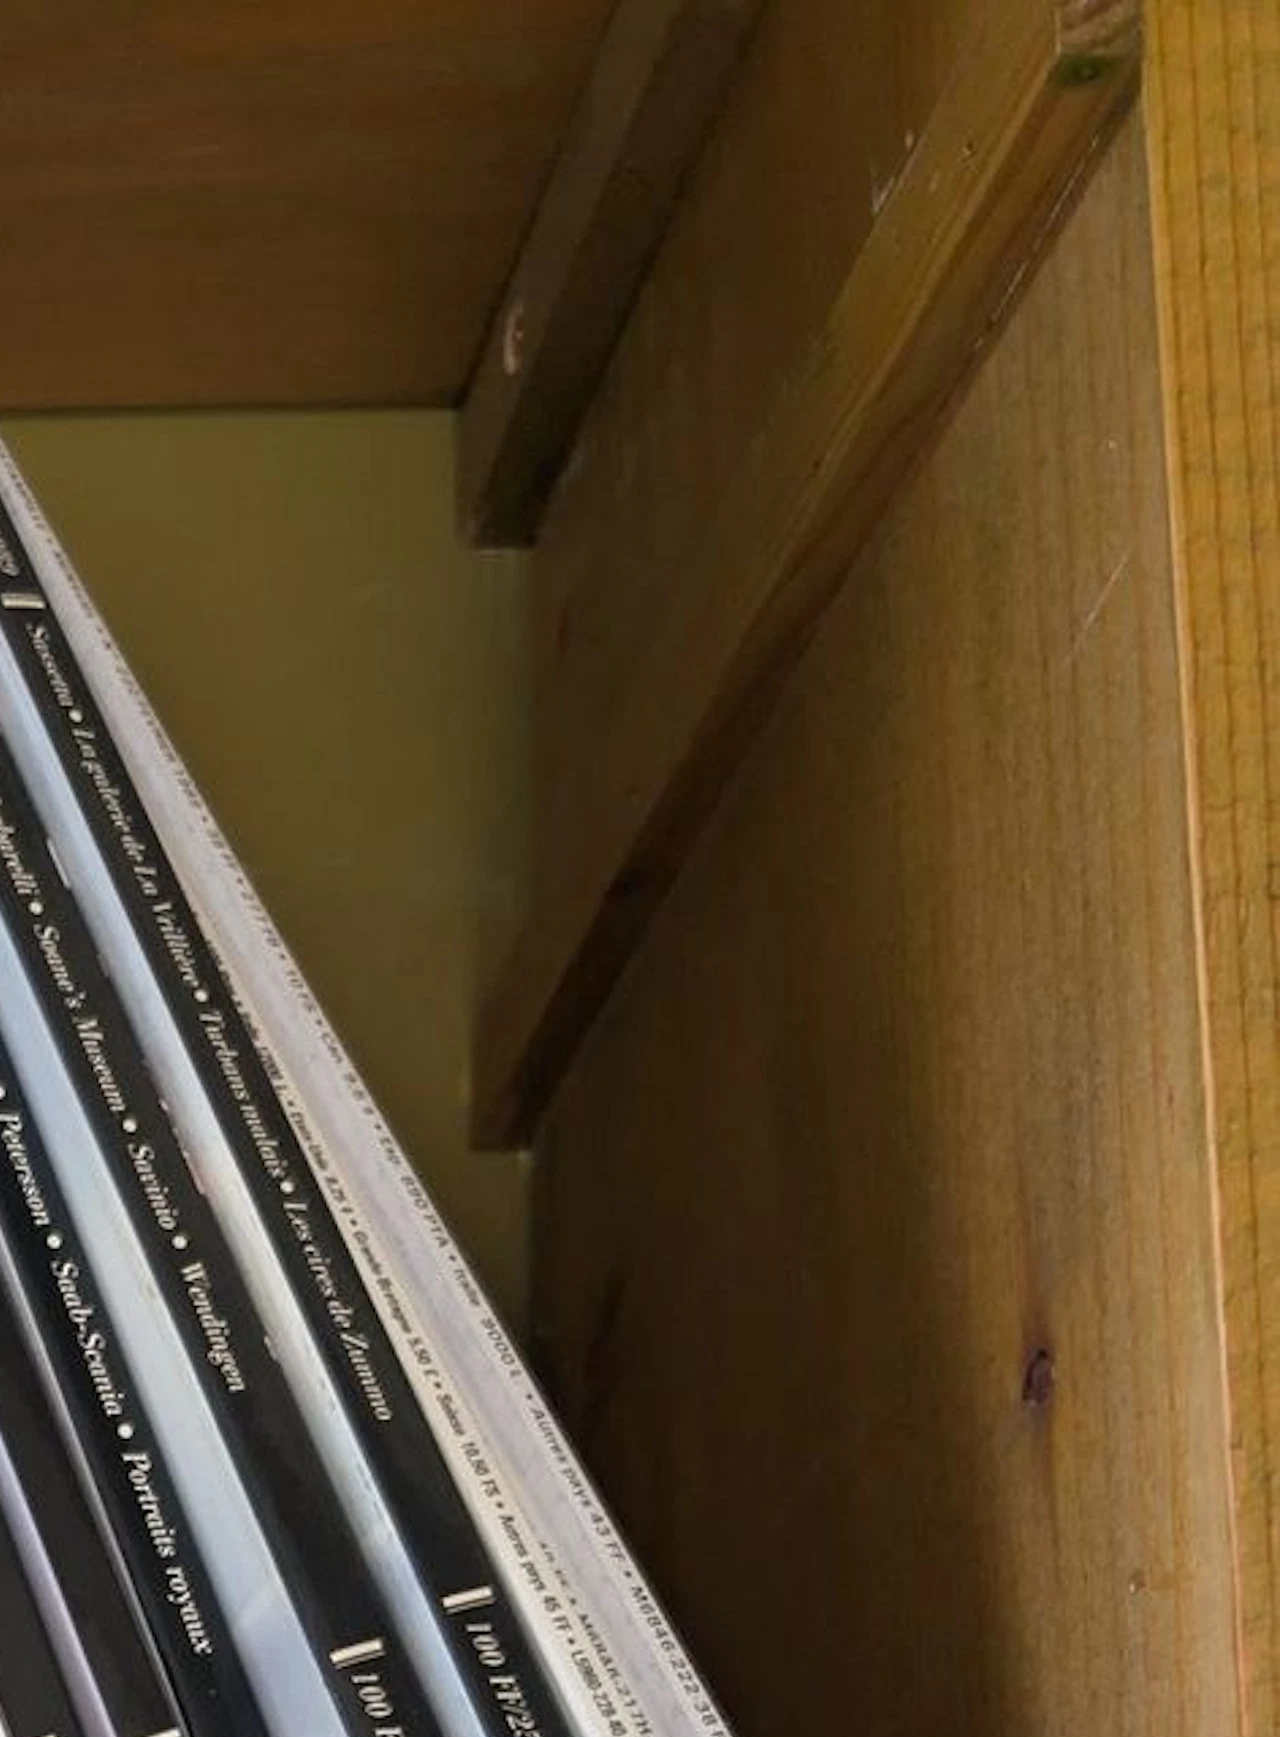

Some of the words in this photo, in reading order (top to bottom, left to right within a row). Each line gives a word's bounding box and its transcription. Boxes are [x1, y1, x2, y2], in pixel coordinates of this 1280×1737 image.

[50, 1260, 125, 1416] Saab-Scania
[121, 1451, 176, 1558] Portraits
[164, 1565, 213, 1654] royaux
[350, 1673, 393, 1718] 100
